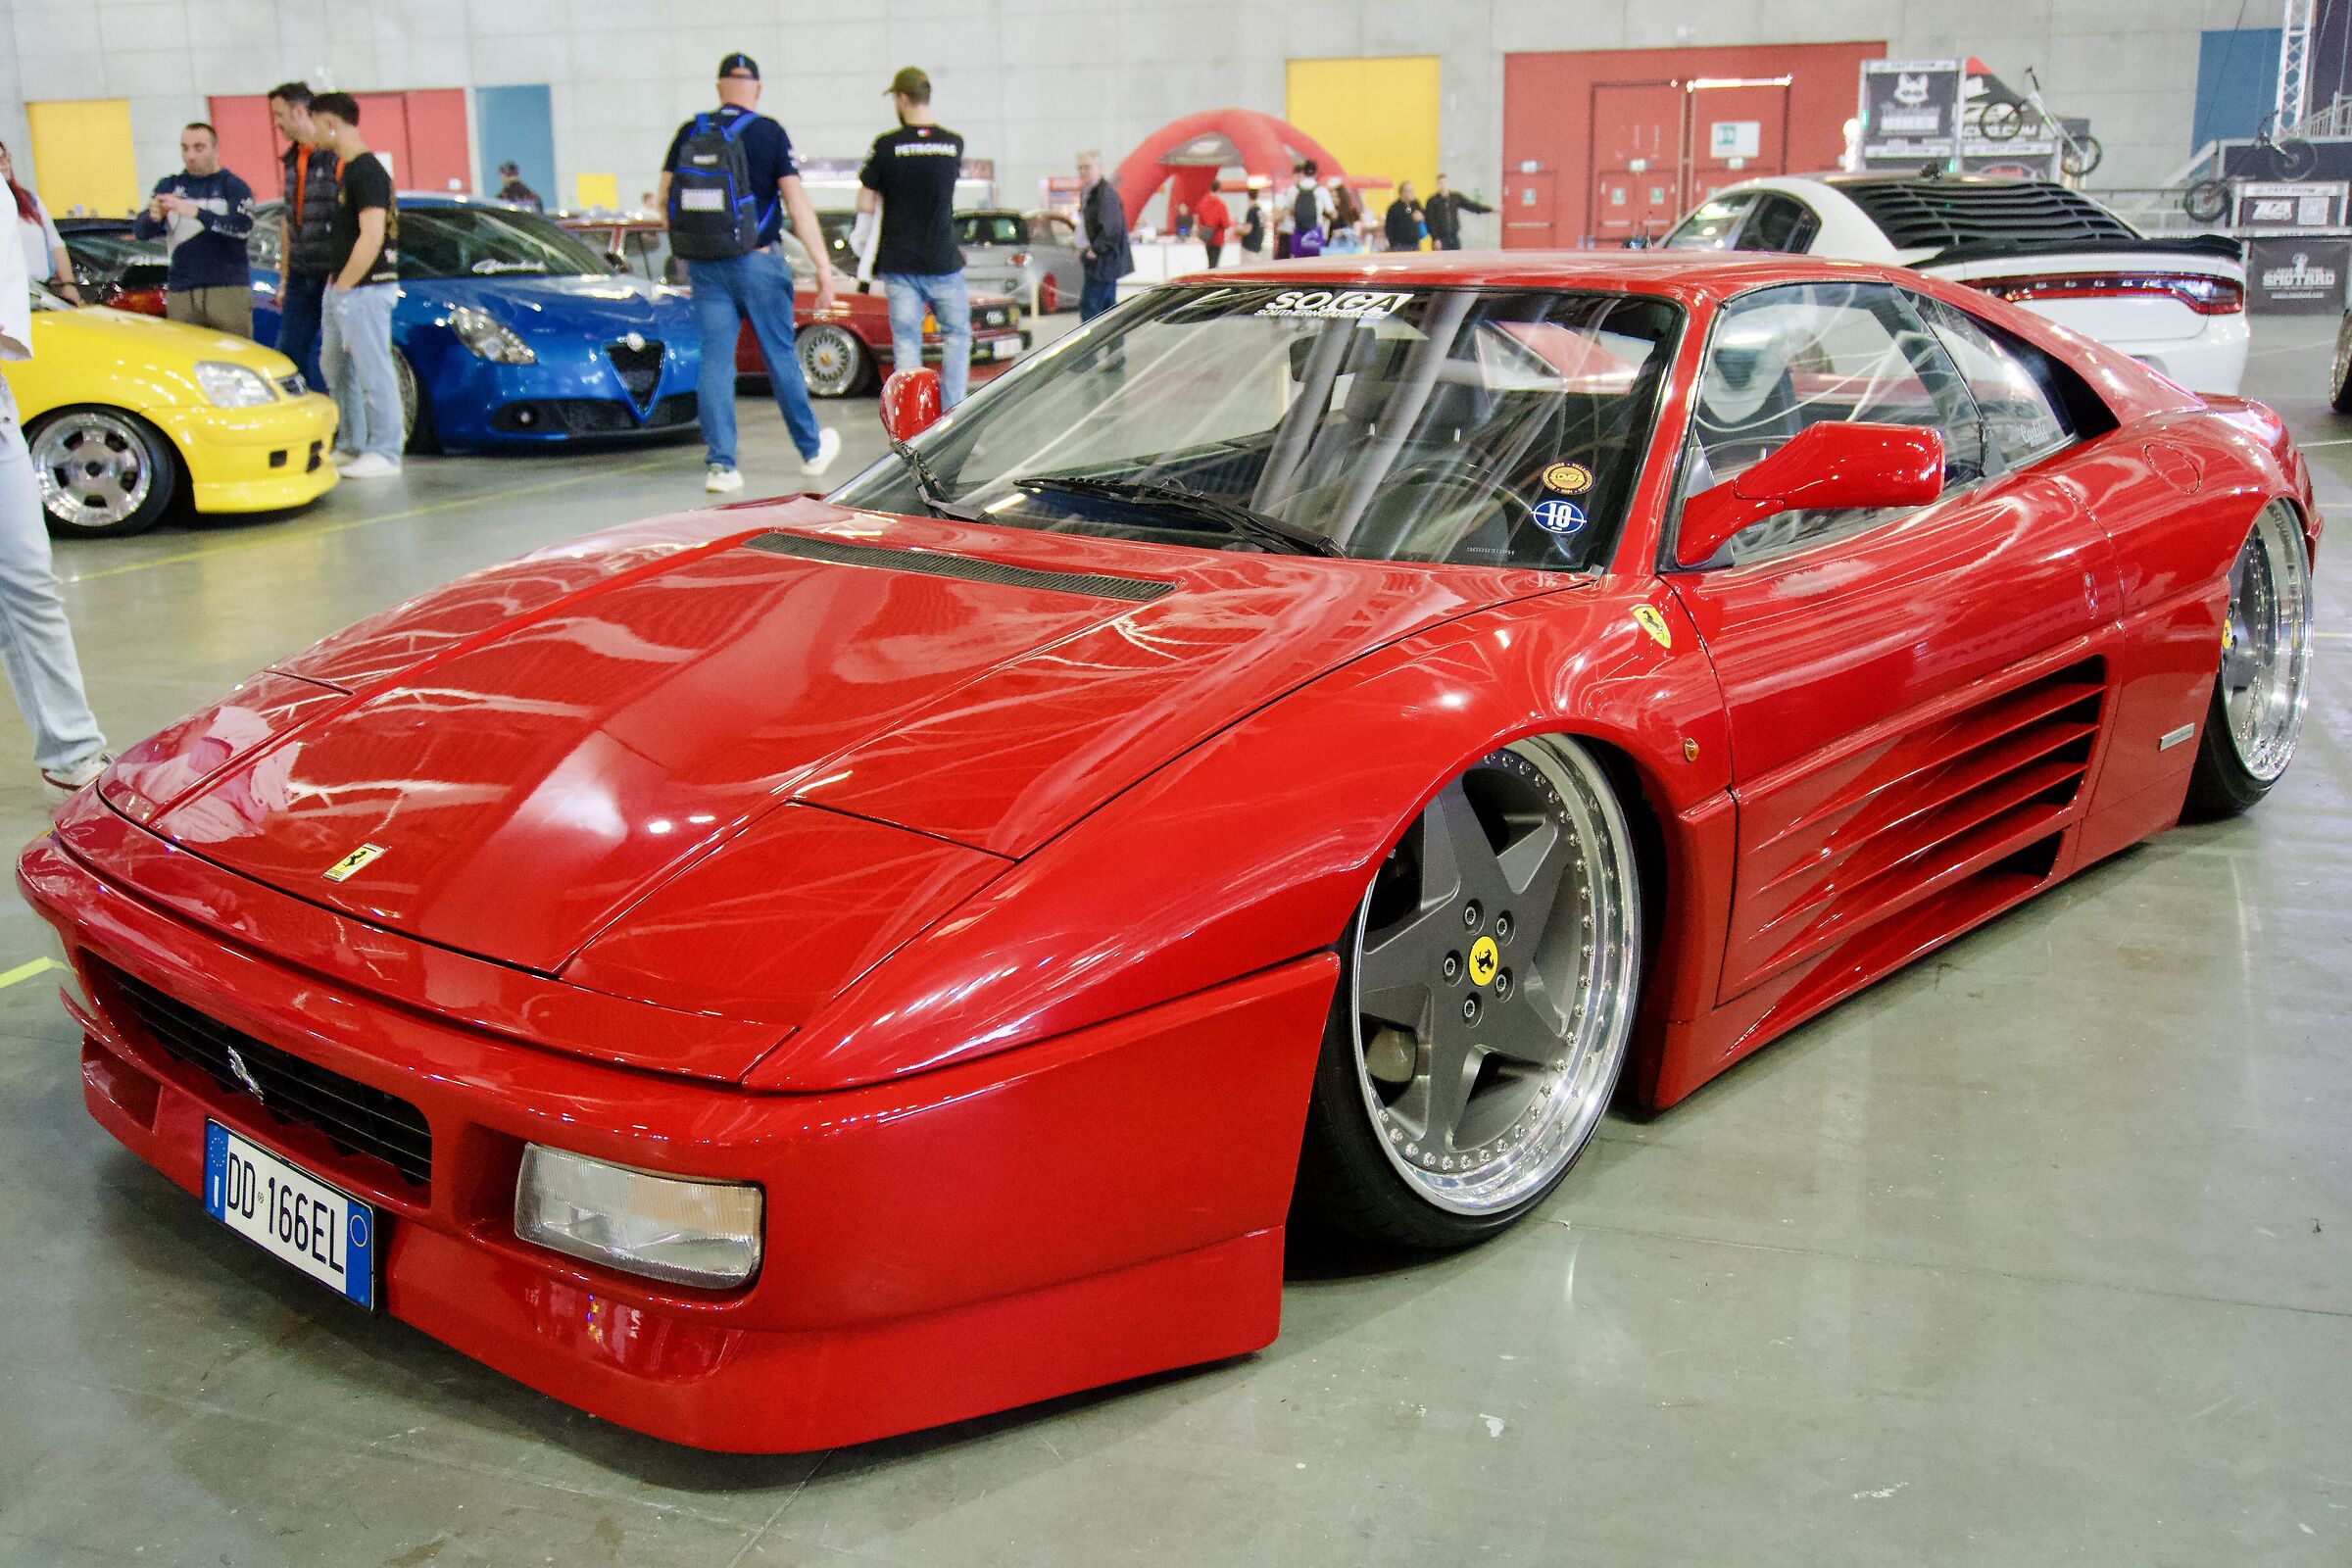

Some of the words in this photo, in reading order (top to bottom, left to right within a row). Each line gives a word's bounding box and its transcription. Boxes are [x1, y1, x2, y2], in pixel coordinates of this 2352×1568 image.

[895, 142, 957, 157] PETRONAS
[1546, 502, 1573, 528] 10
[226, 1151, 256, 1220] DD
[268, 1176, 344, 1275] 166EL
